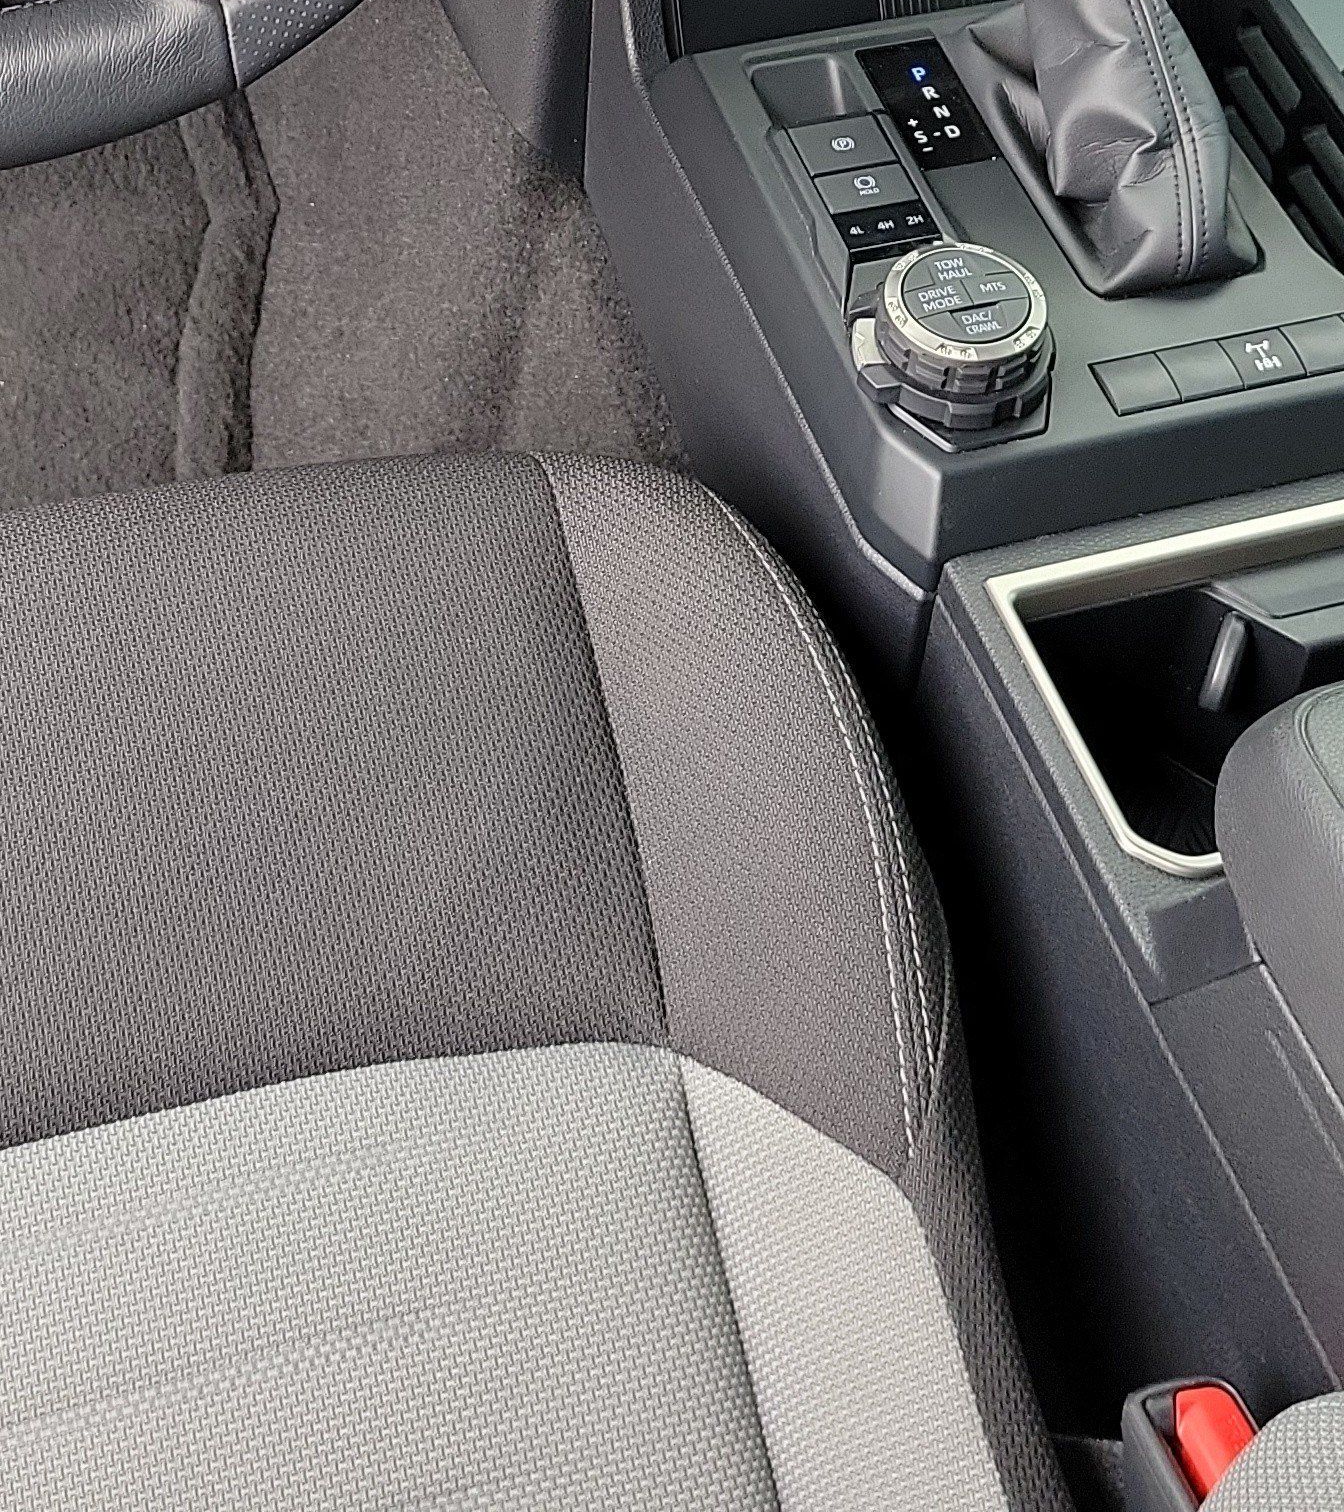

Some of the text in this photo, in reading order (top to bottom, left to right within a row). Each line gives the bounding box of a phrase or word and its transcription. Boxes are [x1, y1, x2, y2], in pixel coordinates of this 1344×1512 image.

[911, 66, 926, 82] P
[921, 86, 940, 100] R
[932, 104, 951, 119] N
[943, 124, 961, 139] D
[849, 214, 925, 235] 4L 4H 2H
[934, 257, 964, 271] TOW
[937, 267, 973, 281] HAUL
[918, 285, 957, 302] DRIVE
[979, 281, 1007, 293] MTS
[922, 294, 963, 312] MODE
[961, 309, 992, 325] DAC/
[965, 321, 1003, 335] CRAWL
